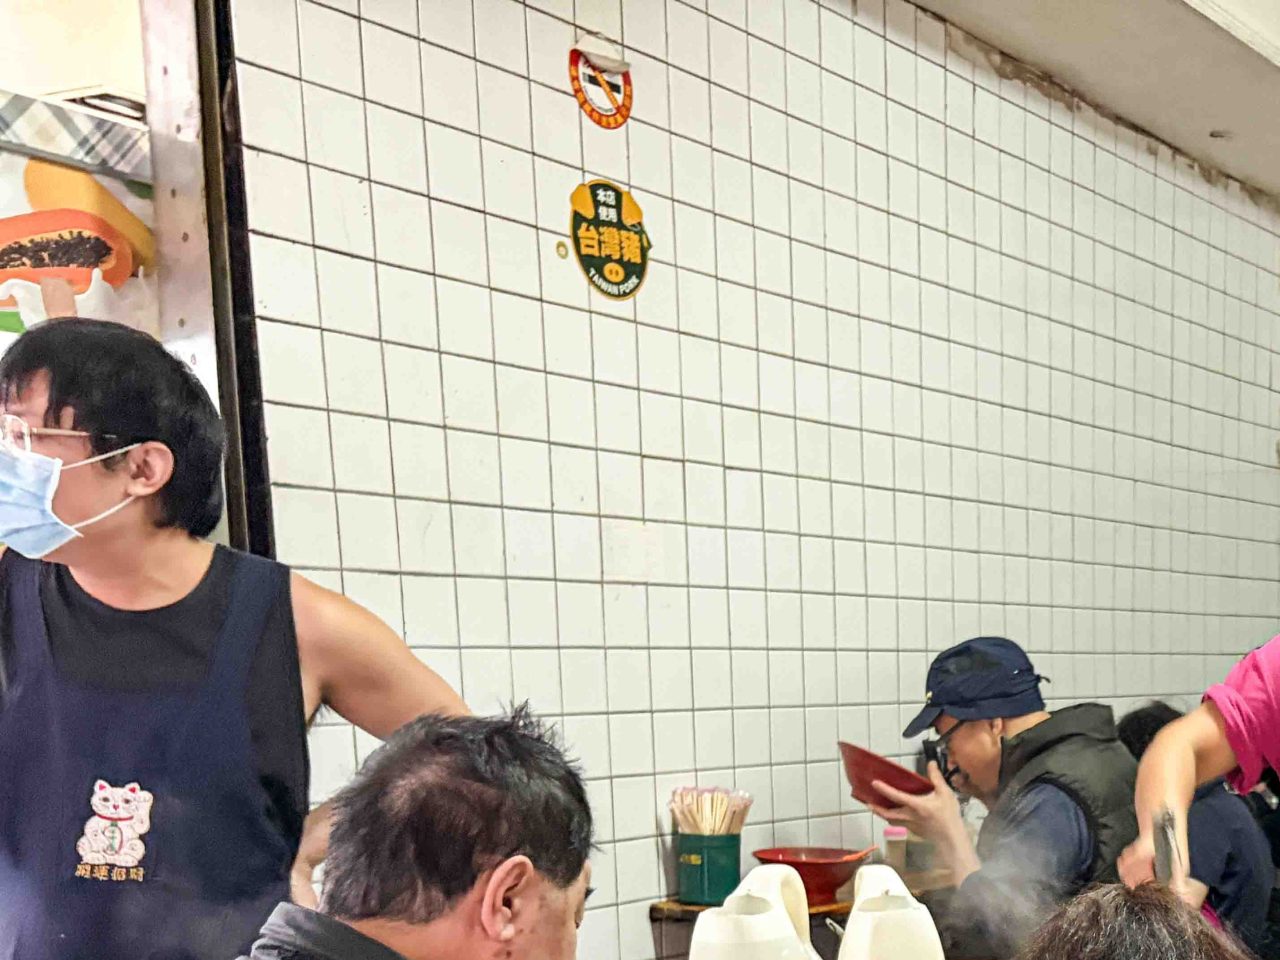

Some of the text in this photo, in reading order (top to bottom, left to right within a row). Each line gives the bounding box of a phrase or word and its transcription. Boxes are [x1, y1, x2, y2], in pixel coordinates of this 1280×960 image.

[578, 223, 642, 264] 台灣豬
[589, 267, 640, 295] TAIWAN PORK
